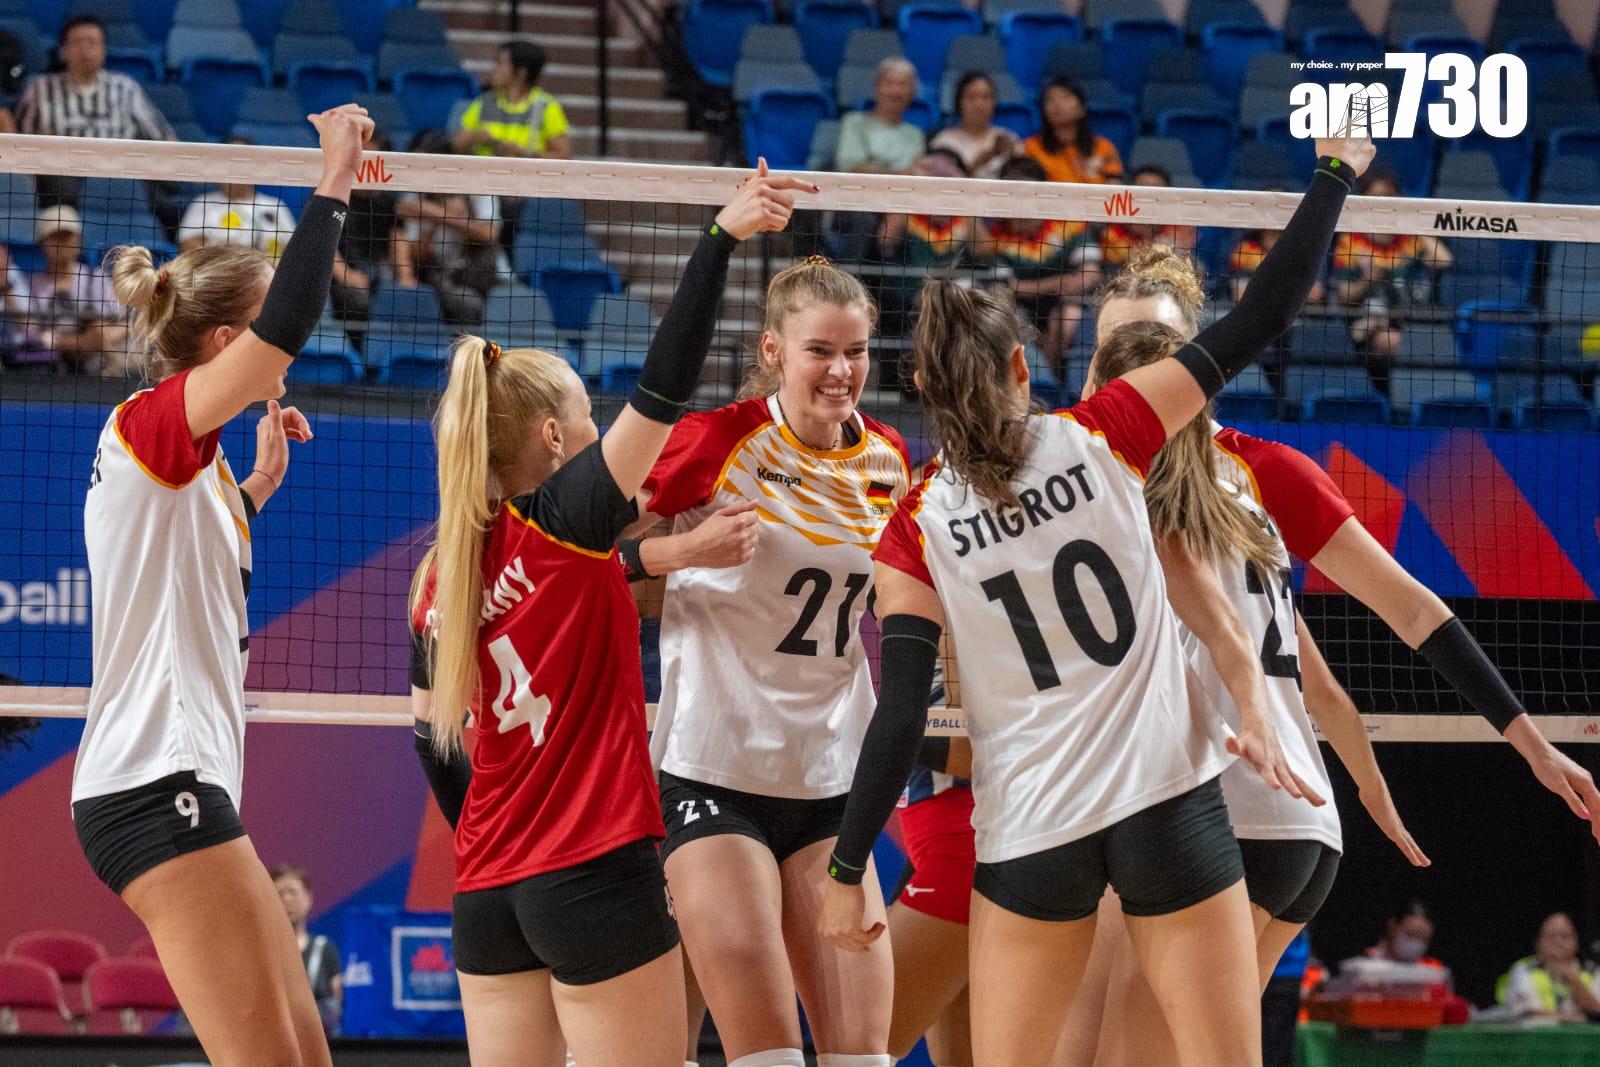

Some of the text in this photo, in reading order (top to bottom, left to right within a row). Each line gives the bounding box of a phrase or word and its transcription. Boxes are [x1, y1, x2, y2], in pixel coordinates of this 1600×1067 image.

[355, 155, 393, 183] VNL
[1104, 189, 1140, 216] VNL
[757, 467, 801, 487] Kempa
[948, 463, 1095, 557] STIGROT
[775, 567, 869, 657] 21
[980, 539, 1137, 692] 10
[488, 634, 552, 747] 4
[175, 791, 200, 828] 9
[677, 799, 719, 826] 21
